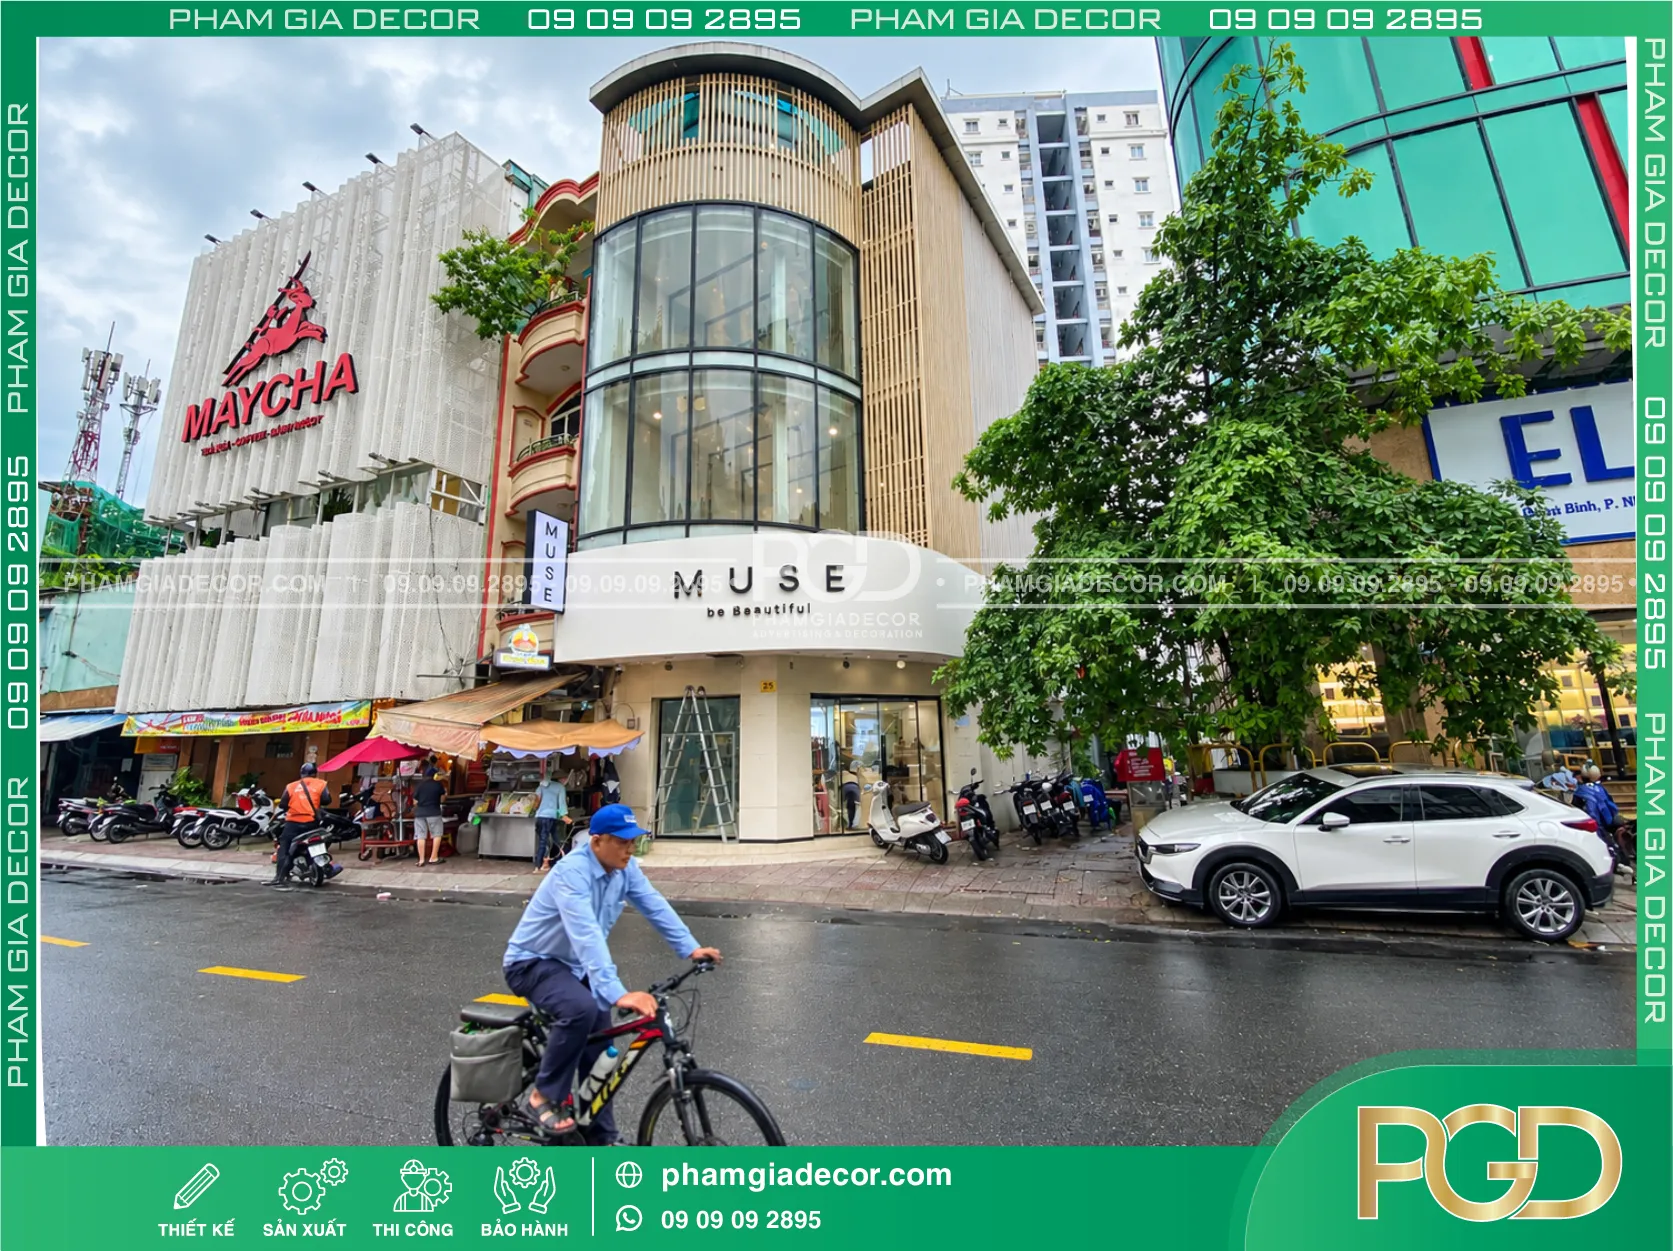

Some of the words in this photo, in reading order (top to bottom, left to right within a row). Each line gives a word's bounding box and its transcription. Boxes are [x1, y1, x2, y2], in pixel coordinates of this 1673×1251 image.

[181, 352, 359, 443] MAYCHA
[545, 521, 558, 603] MUSE
[674, 564, 845, 599] MUSE
[707, 607, 725, 618] be
[733, 602, 811, 617] Beautiful
